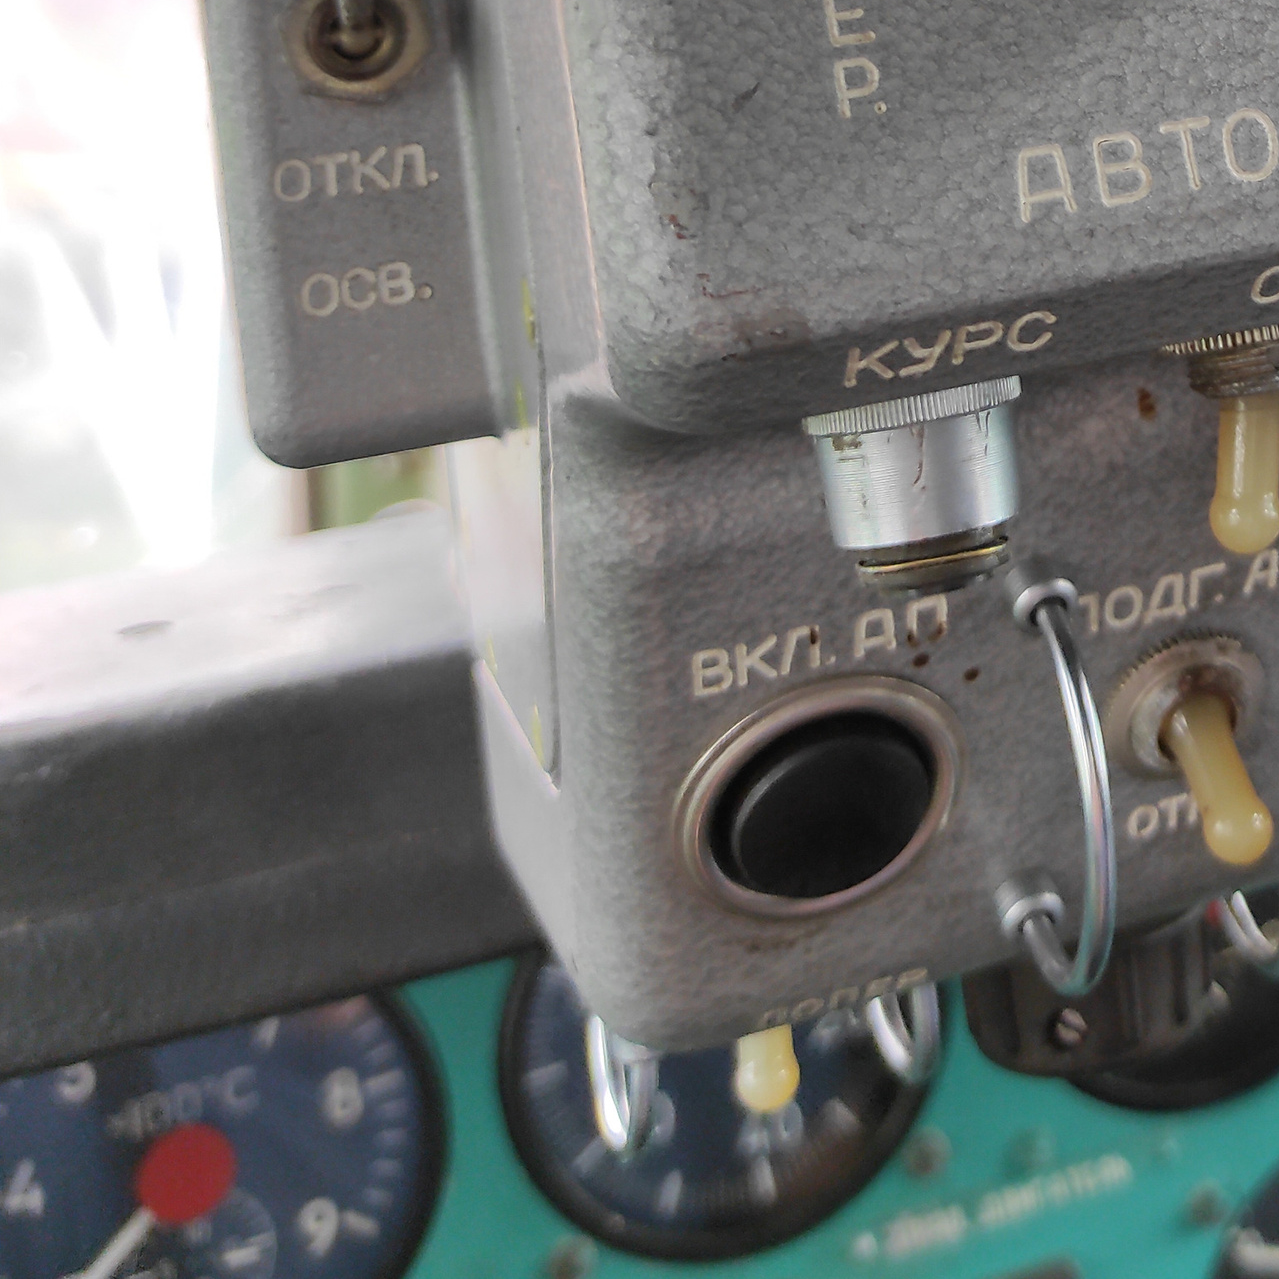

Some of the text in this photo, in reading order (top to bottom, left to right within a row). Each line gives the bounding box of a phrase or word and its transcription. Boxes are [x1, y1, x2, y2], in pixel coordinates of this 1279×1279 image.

[274, 143, 440, 203] ОТКЛ.
[300, 261, 434, 317] ОСВ.
[843, 310, 1058, 388] КУРС
[692, 594, 949, 698] ВКЛ. АП
[298, 1196, 340, 1259] 9
